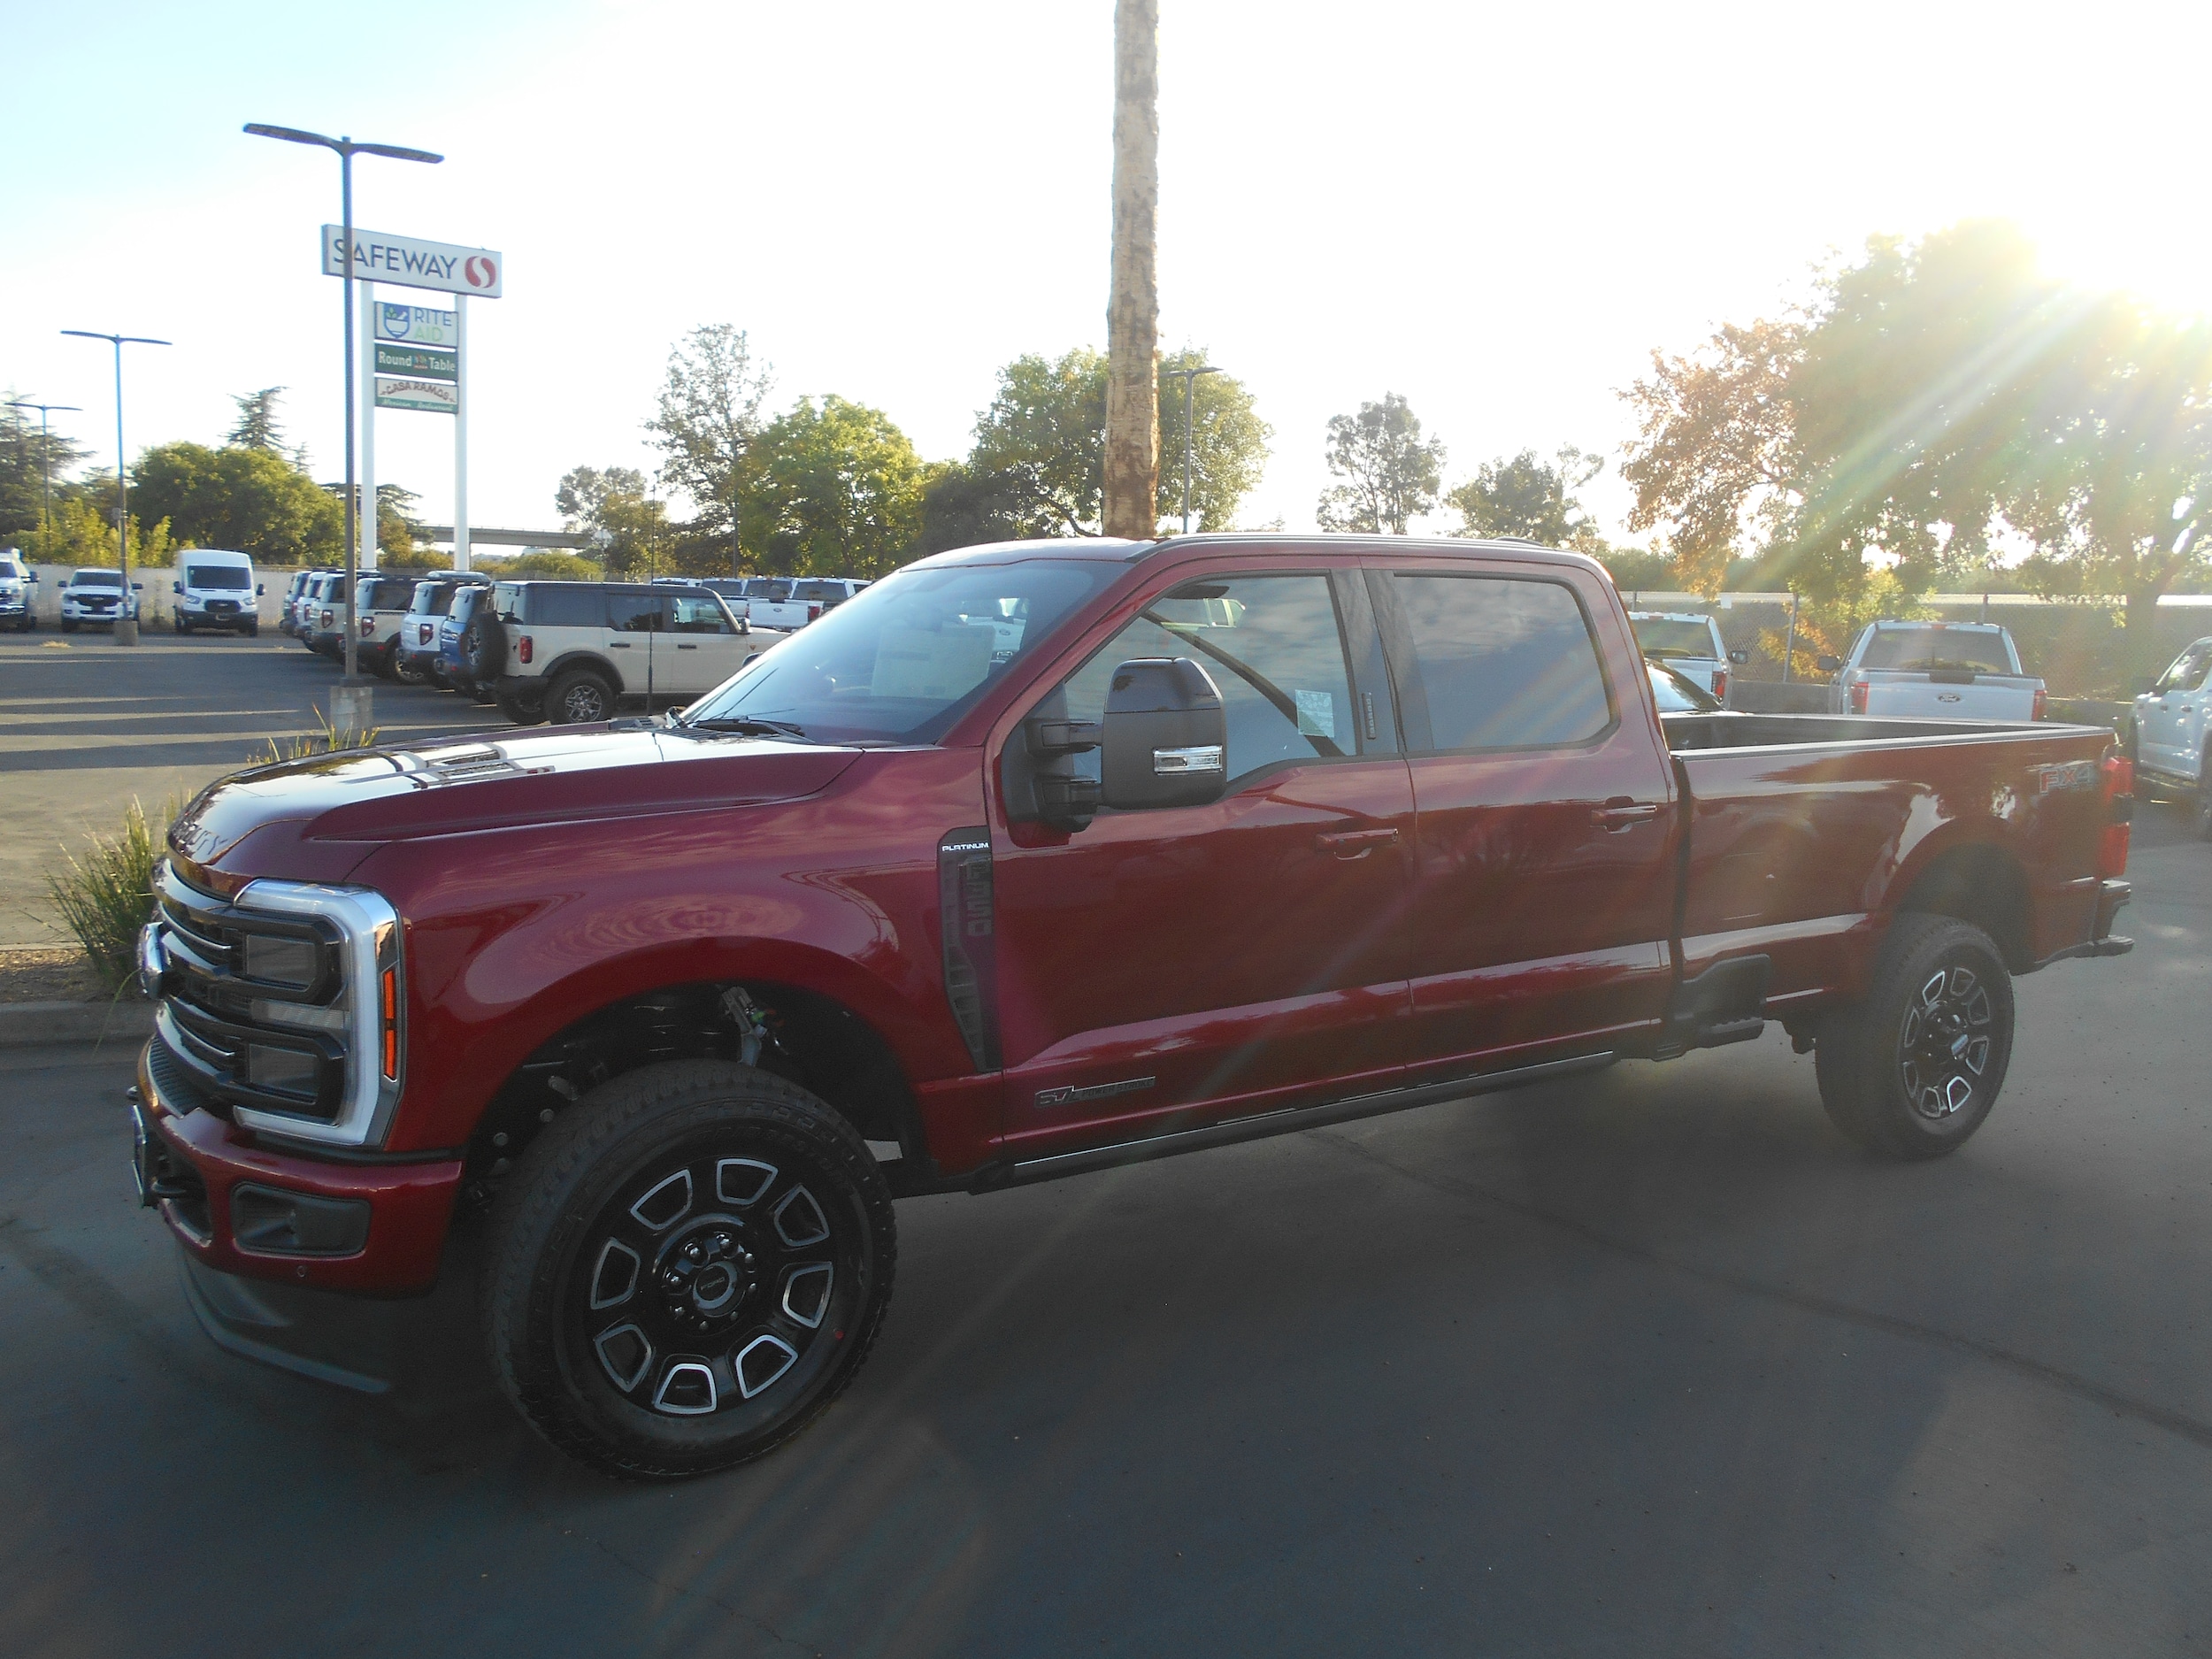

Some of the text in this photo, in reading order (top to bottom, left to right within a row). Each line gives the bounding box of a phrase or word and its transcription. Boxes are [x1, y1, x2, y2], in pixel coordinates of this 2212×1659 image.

[333, 238, 458, 280] SAFEWAY
[414, 308, 452, 326] RITE
[414, 325, 443, 342] AID
[378, 350, 456, 372] Round Table
[386, 381, 450, 401] CASA RAMOS
[2039, 764, 2095, 796] FX4
[941, 841, 989, 852] PLATINUM
